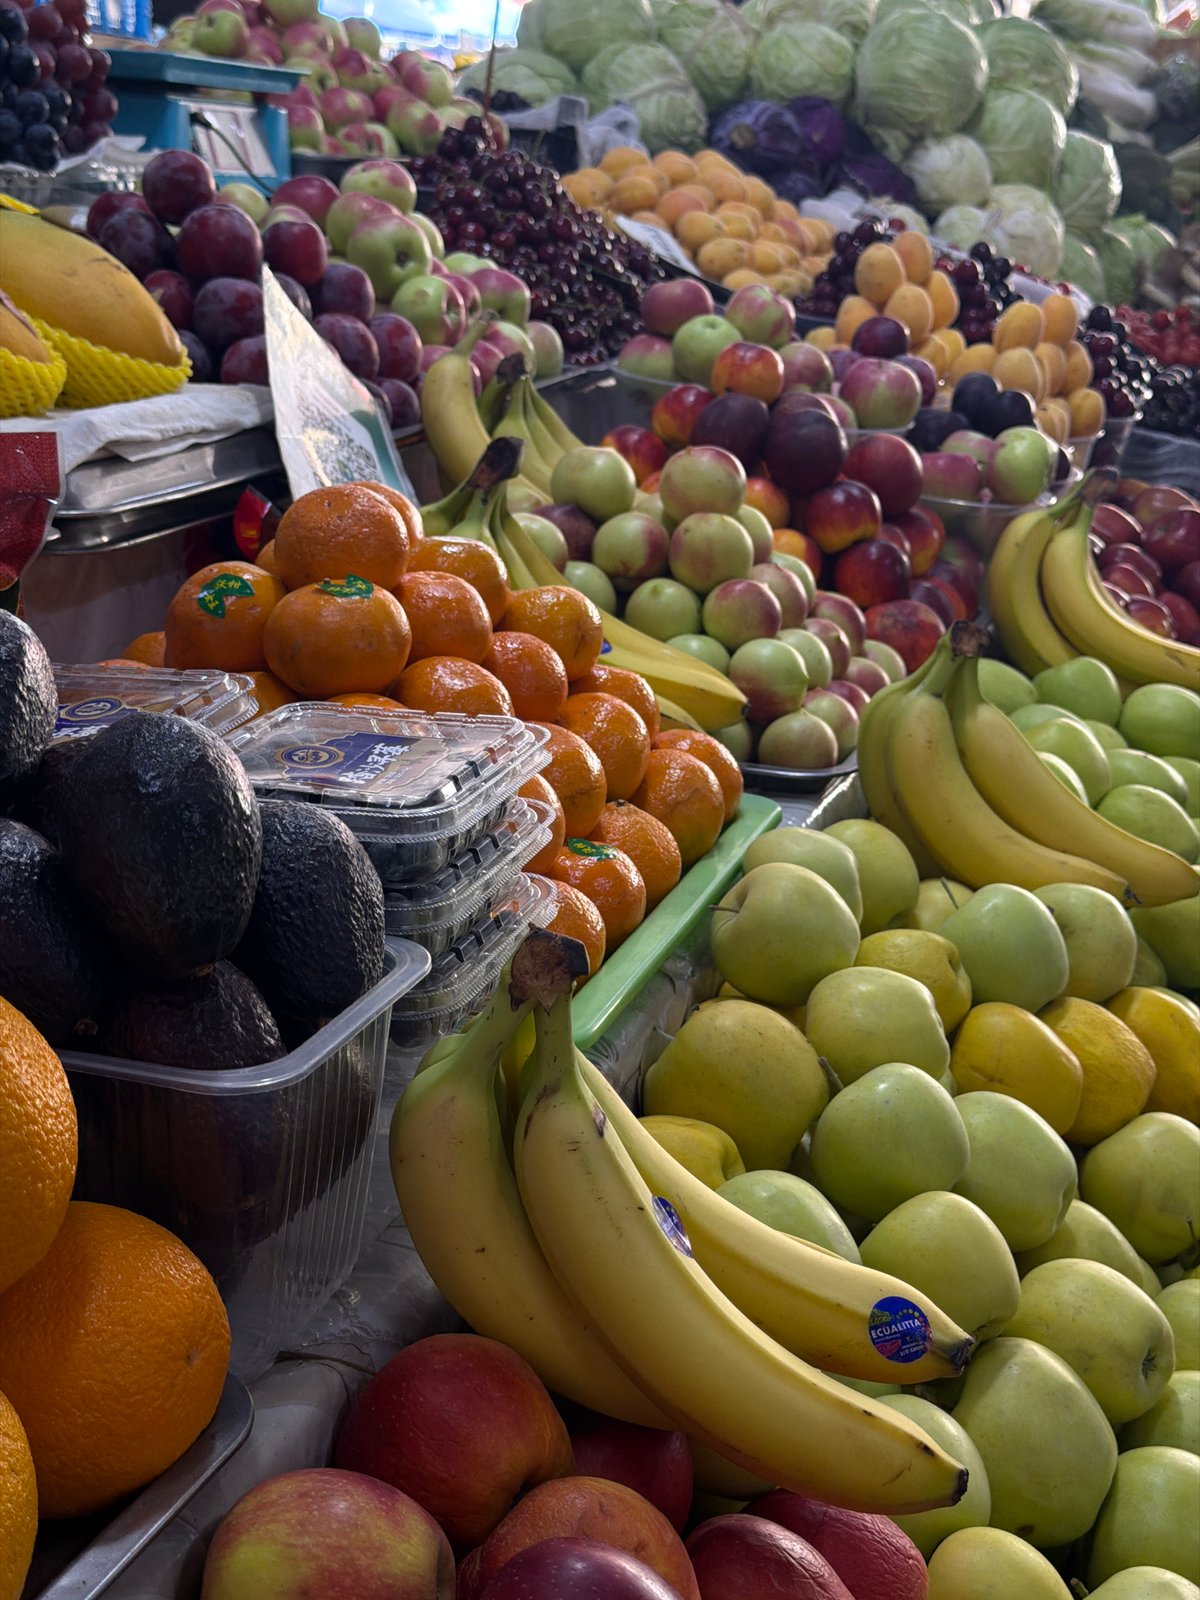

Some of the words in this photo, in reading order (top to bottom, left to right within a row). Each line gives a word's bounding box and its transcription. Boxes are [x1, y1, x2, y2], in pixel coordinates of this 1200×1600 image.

[338, 742, 410, 784] 踏沙寻莓
[870, 1318, 921, 1339] ECUALITTA
